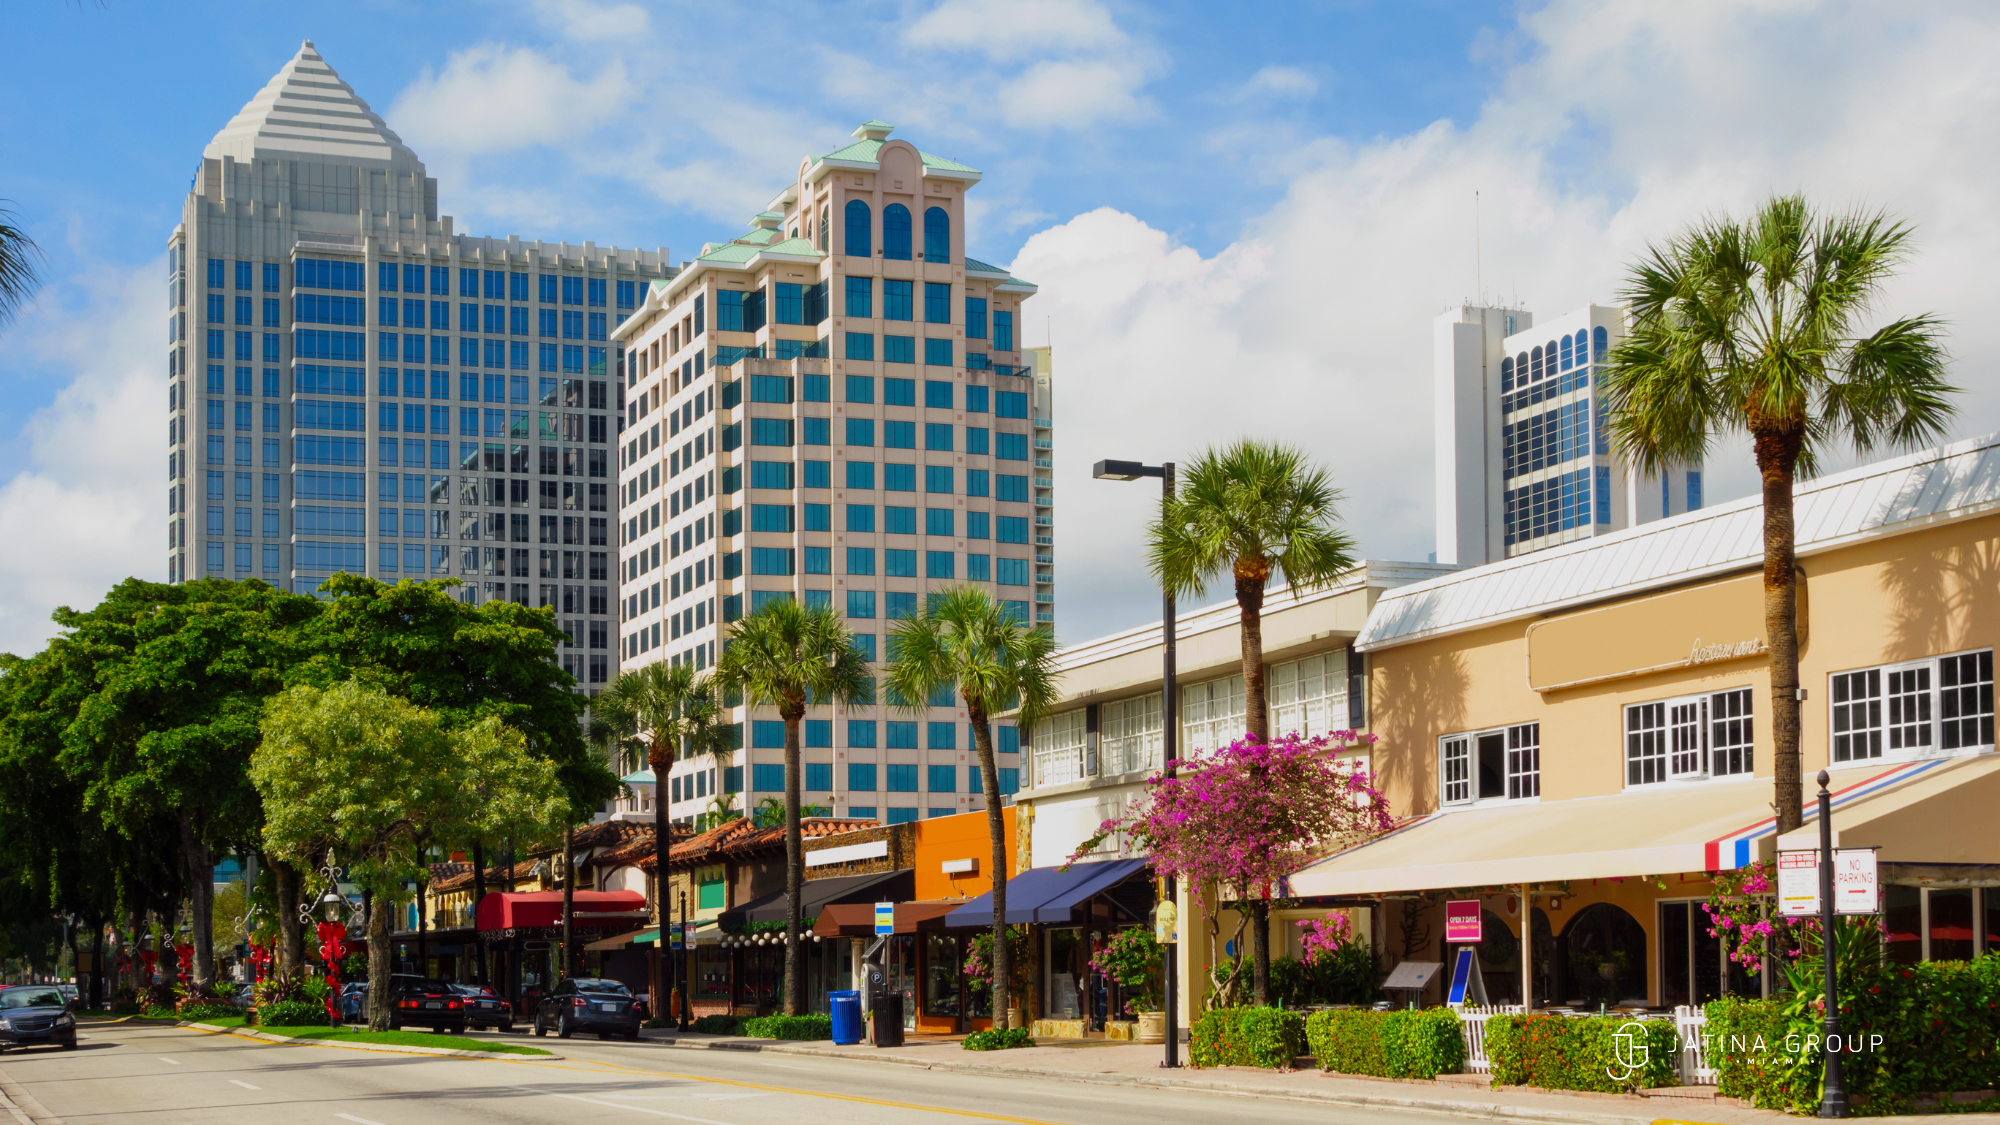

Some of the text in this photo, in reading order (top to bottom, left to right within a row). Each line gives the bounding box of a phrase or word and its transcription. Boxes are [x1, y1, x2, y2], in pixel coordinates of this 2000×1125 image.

[1685, 636, 1759, 666] Restaurant
[1849, 859, 1861, 871] NO
[1839, 872, 1873, 884] PARKING
